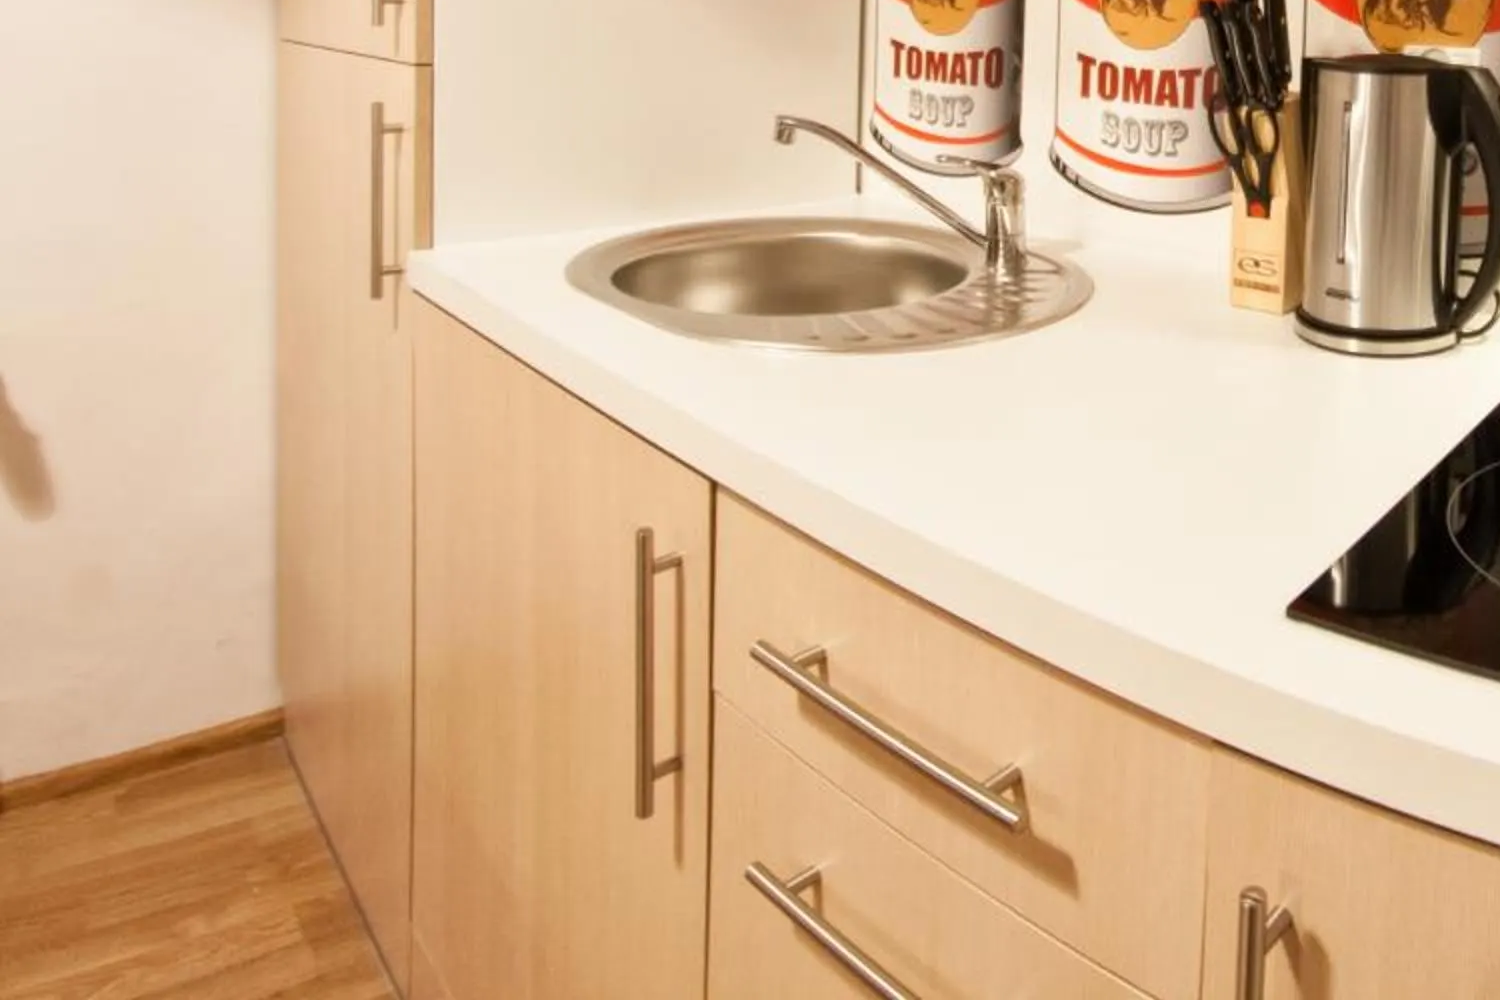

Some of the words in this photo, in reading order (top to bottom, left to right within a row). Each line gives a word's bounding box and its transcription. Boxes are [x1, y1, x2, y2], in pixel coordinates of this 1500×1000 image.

[890, 38, 1005, 89] TOMATO
[908, 87, 975, 129] SOUP
[1101, 110, 1190, 158] SOUP
